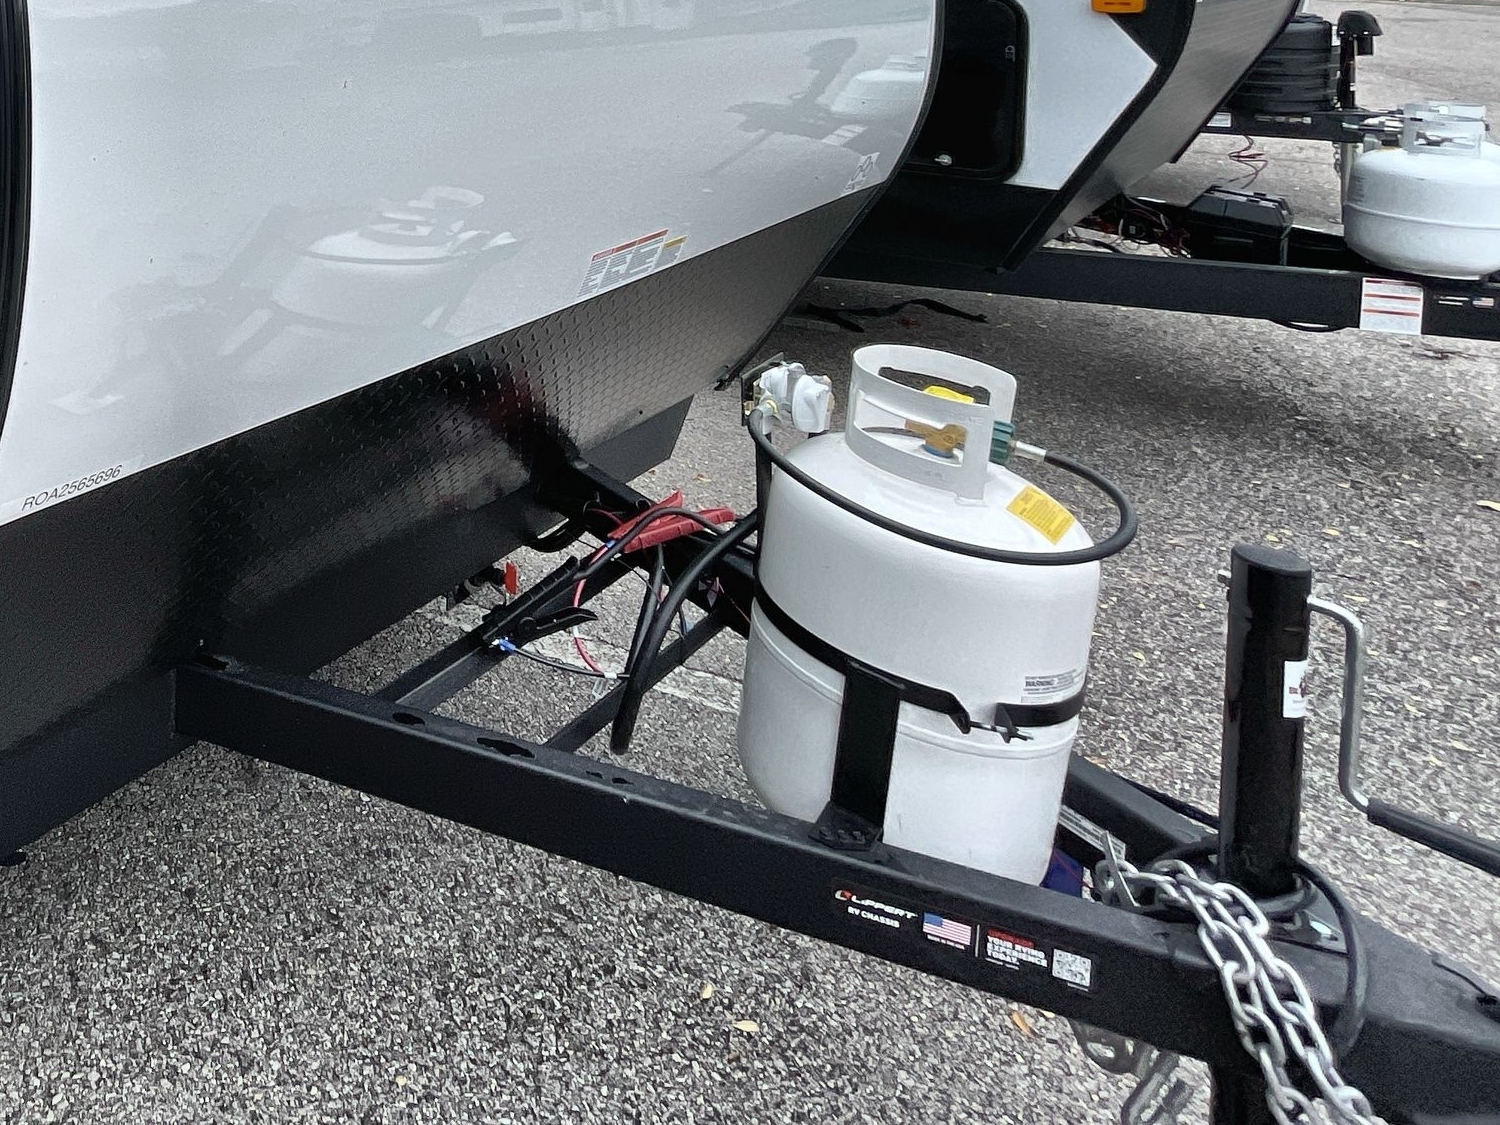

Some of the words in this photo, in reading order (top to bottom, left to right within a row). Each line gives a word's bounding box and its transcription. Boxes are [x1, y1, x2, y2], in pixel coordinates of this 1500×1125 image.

[21, 464, 123, 511] ROA2565696
[847, 905, 860, 916] RV
[860, 910, 900, 929] CHASSIS
[850, 894, 918, 919] LIPPERT
[986, 942, 1048, 967] EXPERIENCE
[987, 935, 1013, 950] YOUR
